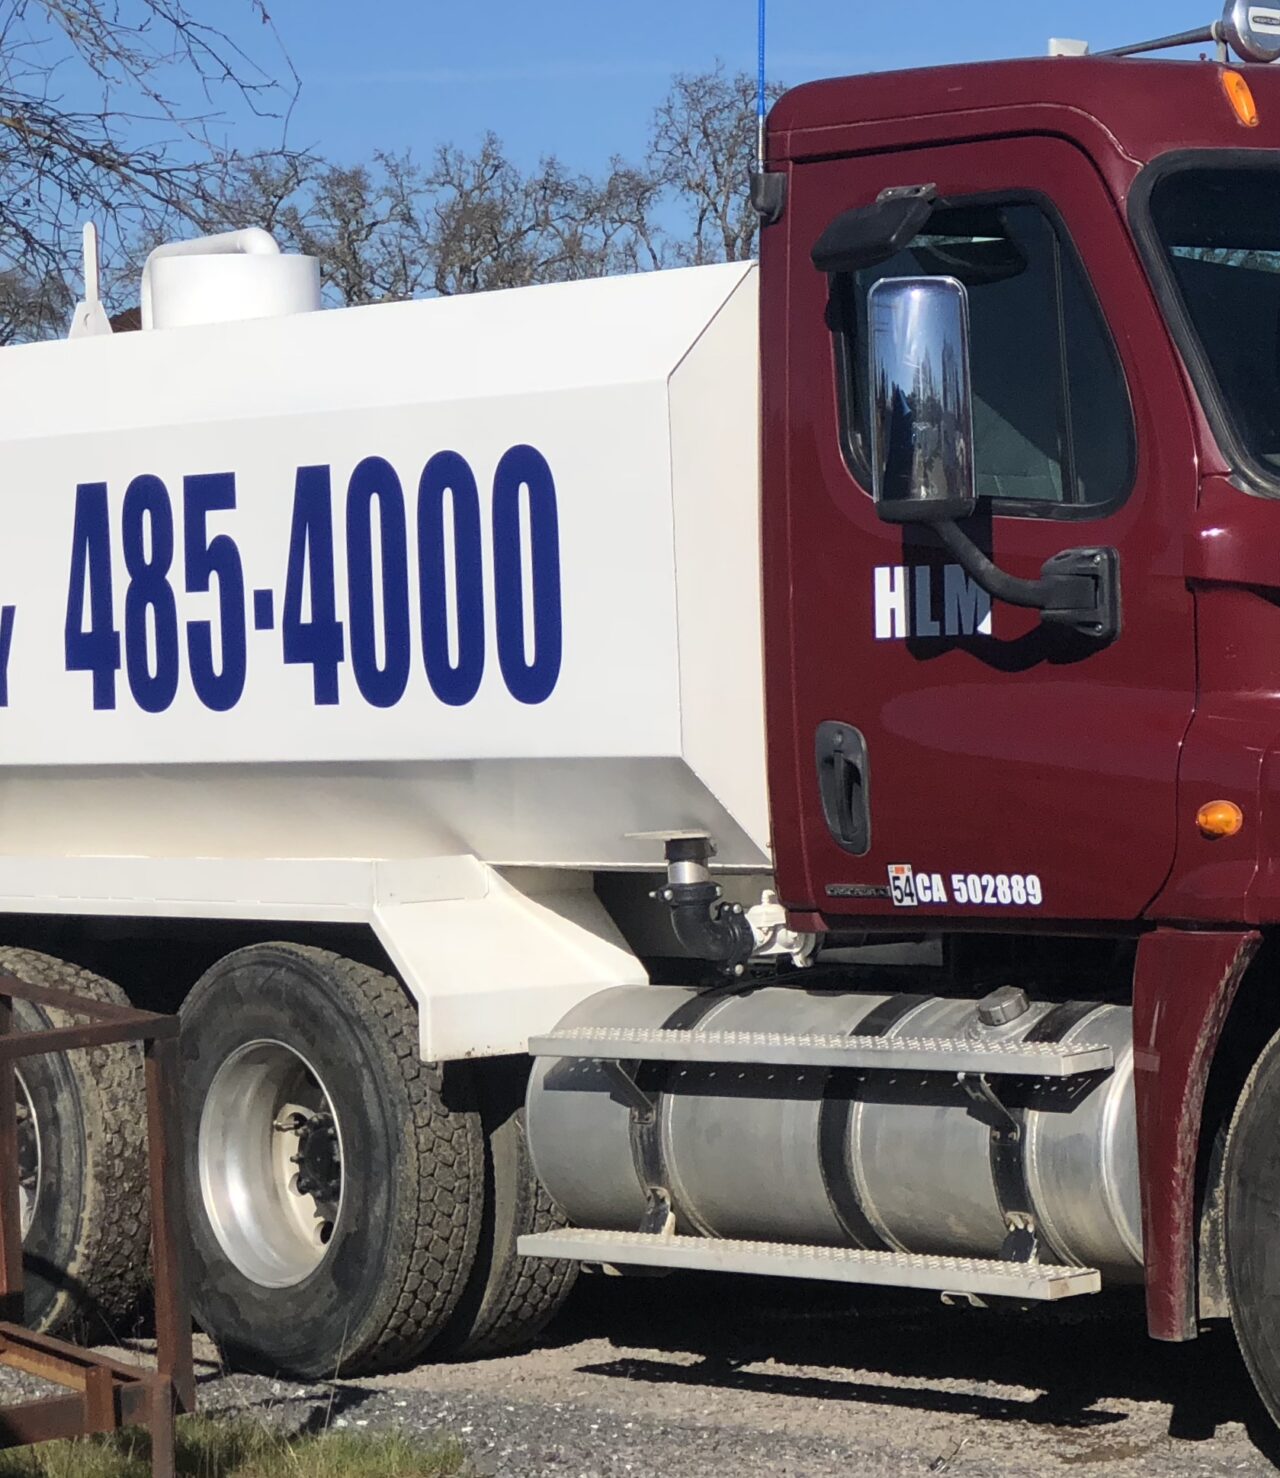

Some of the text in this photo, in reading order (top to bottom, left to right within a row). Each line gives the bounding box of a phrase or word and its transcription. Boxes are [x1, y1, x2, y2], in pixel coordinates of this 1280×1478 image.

[65, 444, 562, 713] 485-4000
[874, 564, 992, 638] HLM
[892, 875, 915, 904] 54
[915, 873, 1042, 904] CA 502889
